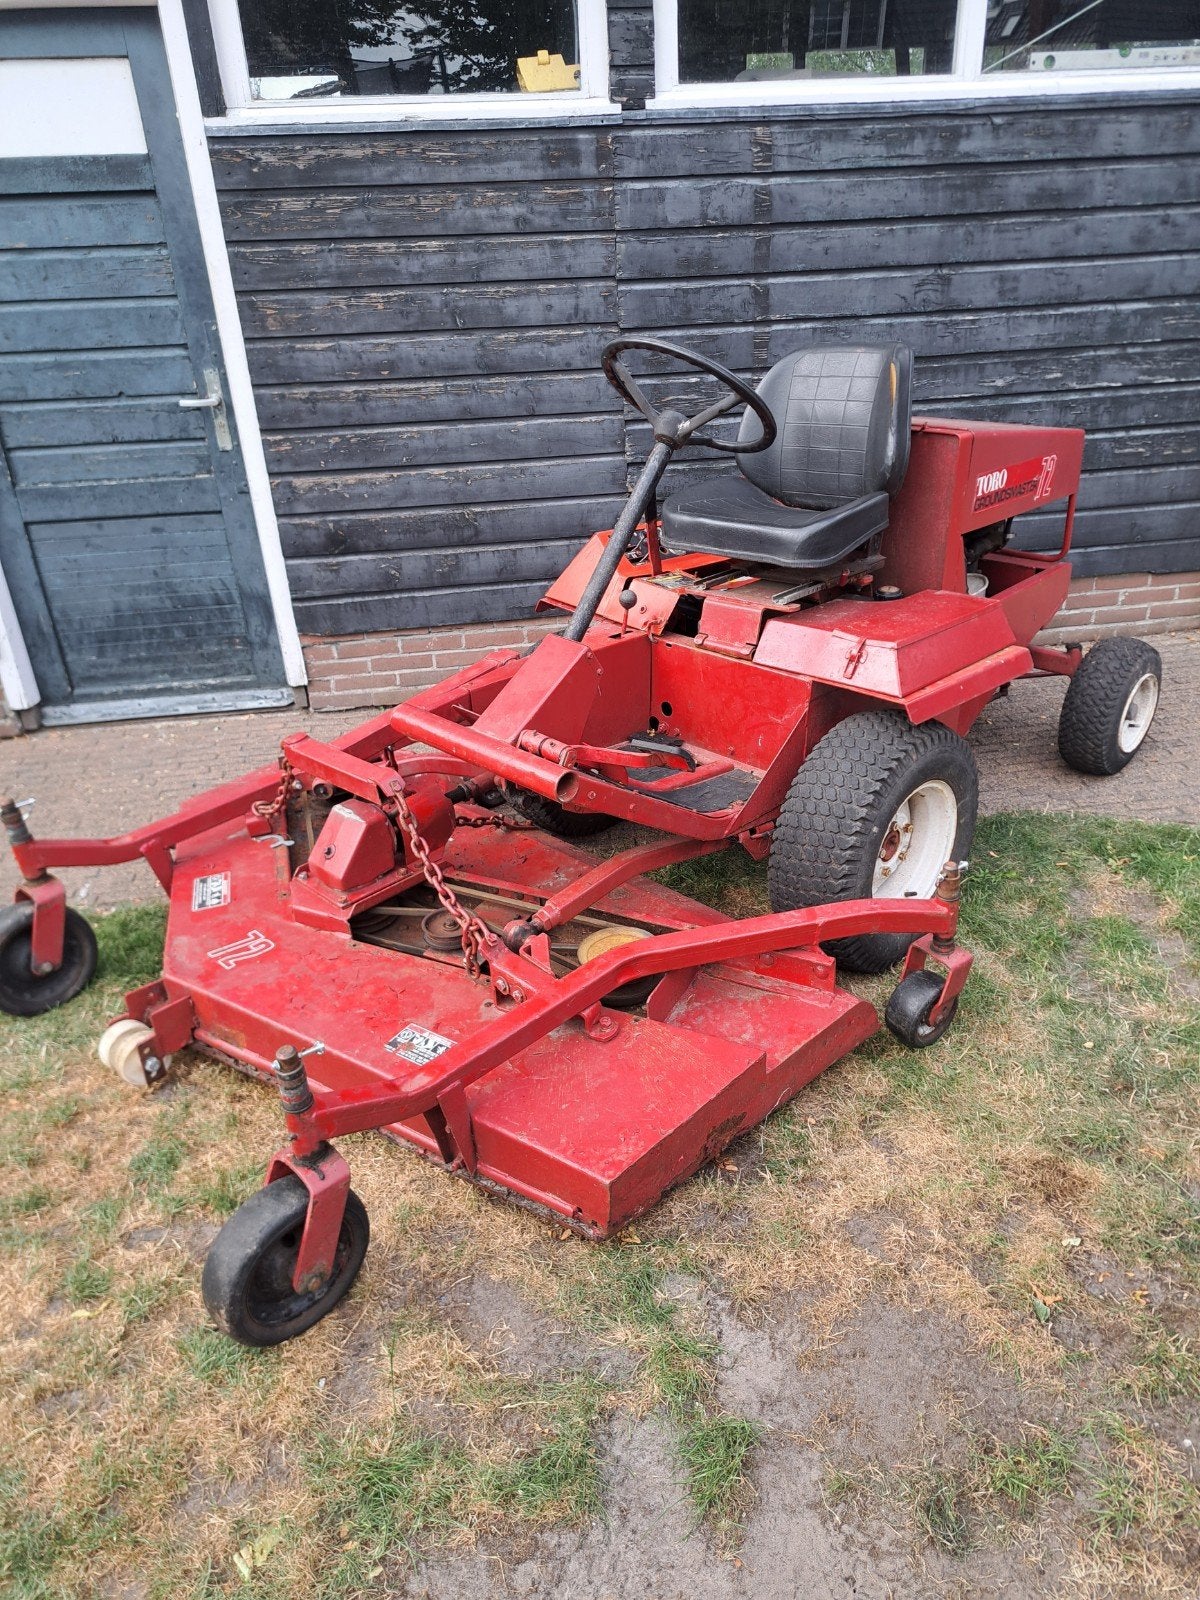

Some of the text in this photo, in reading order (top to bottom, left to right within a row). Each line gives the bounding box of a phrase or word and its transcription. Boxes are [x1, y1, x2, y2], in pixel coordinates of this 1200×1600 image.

[976, 468, 1008, 497] TORO
[1034, 454, 1057, 501] 72
[974, 481, 1037, 511] GROUNDSMASTER
[206, 930, 275, 970] 72
